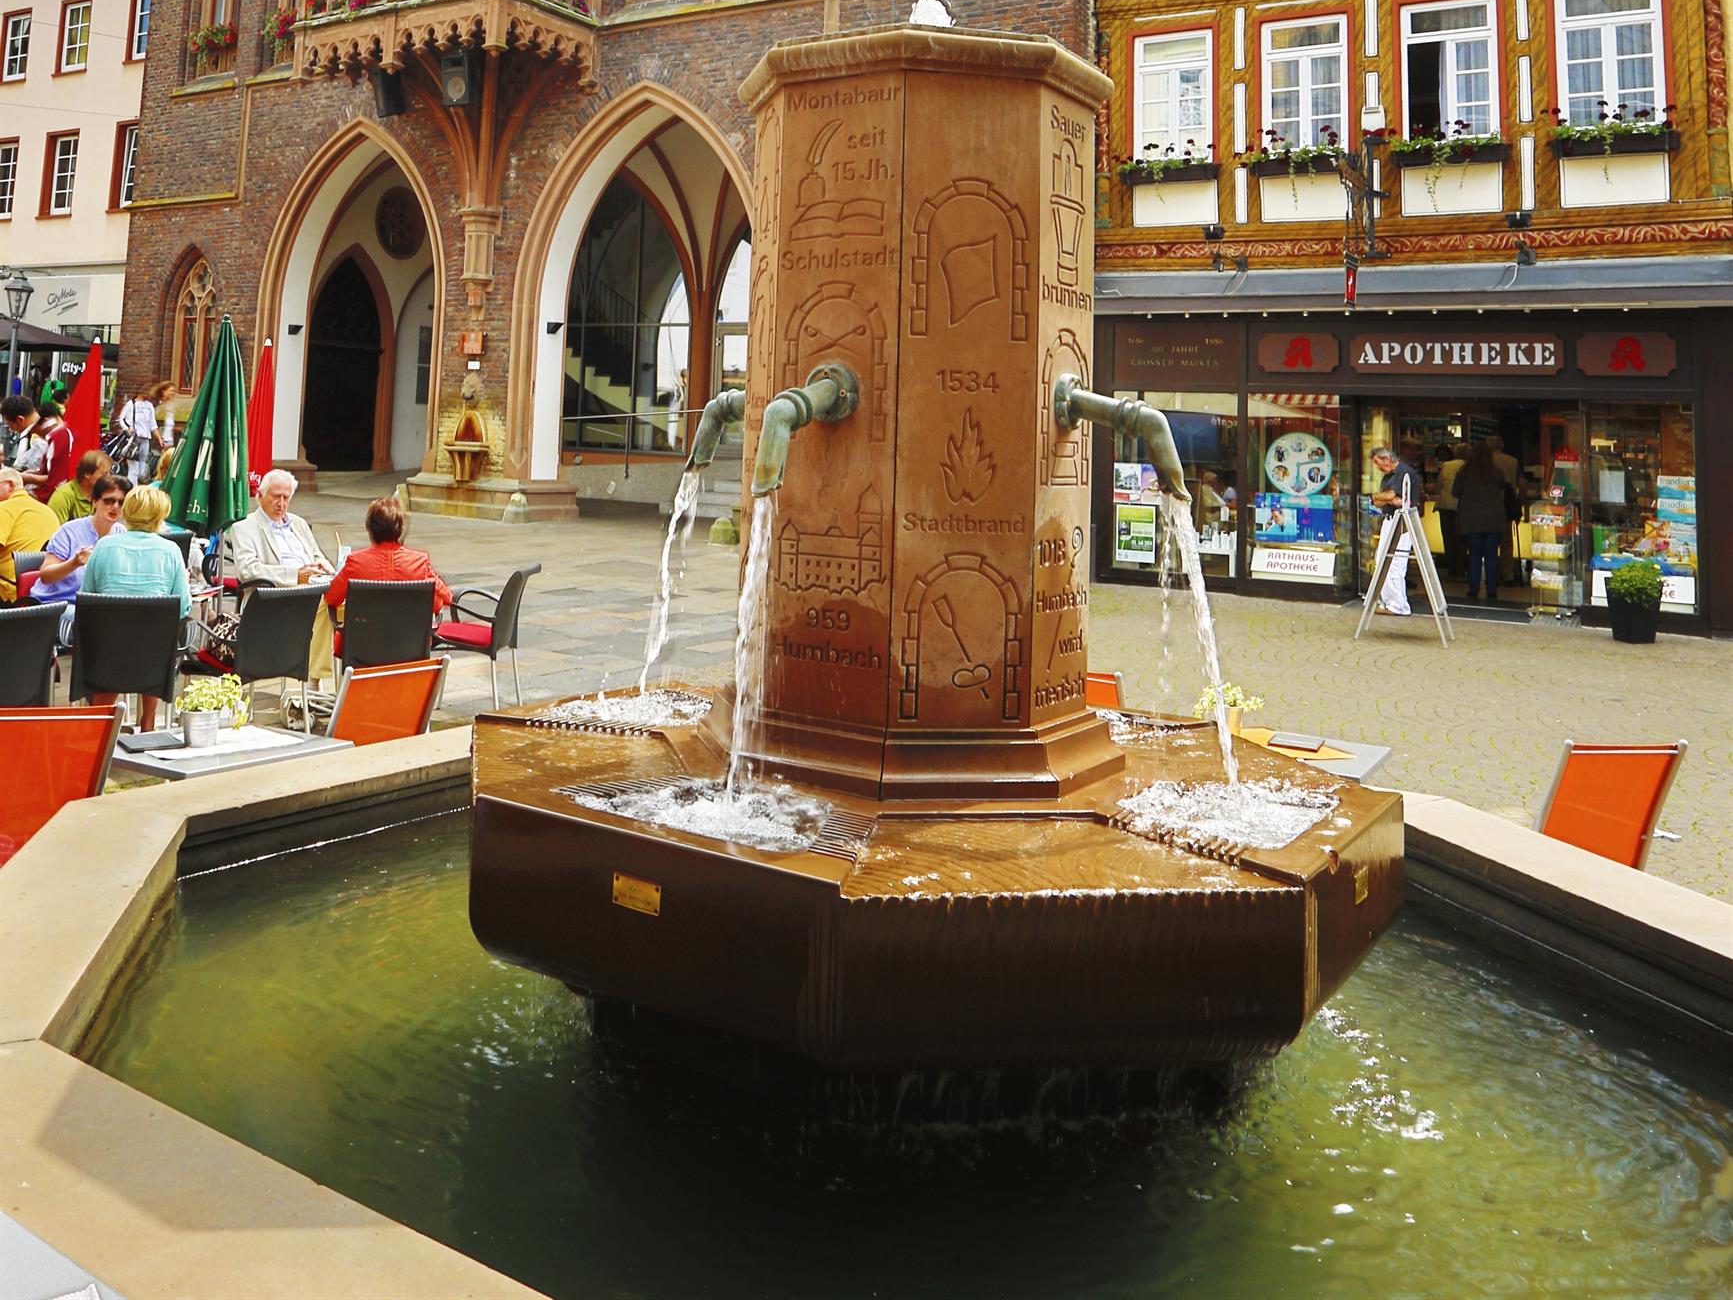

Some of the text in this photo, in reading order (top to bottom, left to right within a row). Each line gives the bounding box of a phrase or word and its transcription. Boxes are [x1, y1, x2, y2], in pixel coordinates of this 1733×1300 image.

[787, 86, 901, 113] Montabaur
[1051, 104, 1086, 142] Sauer
[847, 127, 887, 150] seit
[831, 158, 895, 183] 15 Jh.
[782, 248, 899, 271] Schulstadt
[1042, 276, 1093, 311] brunnen
[1358, 342, 1556, 366] APOTHEKE
[936, 370, 1000, 394] 1534
[903, 512, 1025, 536] Stadtbrand
[1037, 538, 1067, 568] 1018
[1267, 552, 1320, 562] RATHAUS-
[1266, 561, 1319, 572] APOTHEKE
[1036, 585, 1087, 615] Humbach
[807, 607, 850, 631] 959
[771, 634, 881, 669] Humbach
